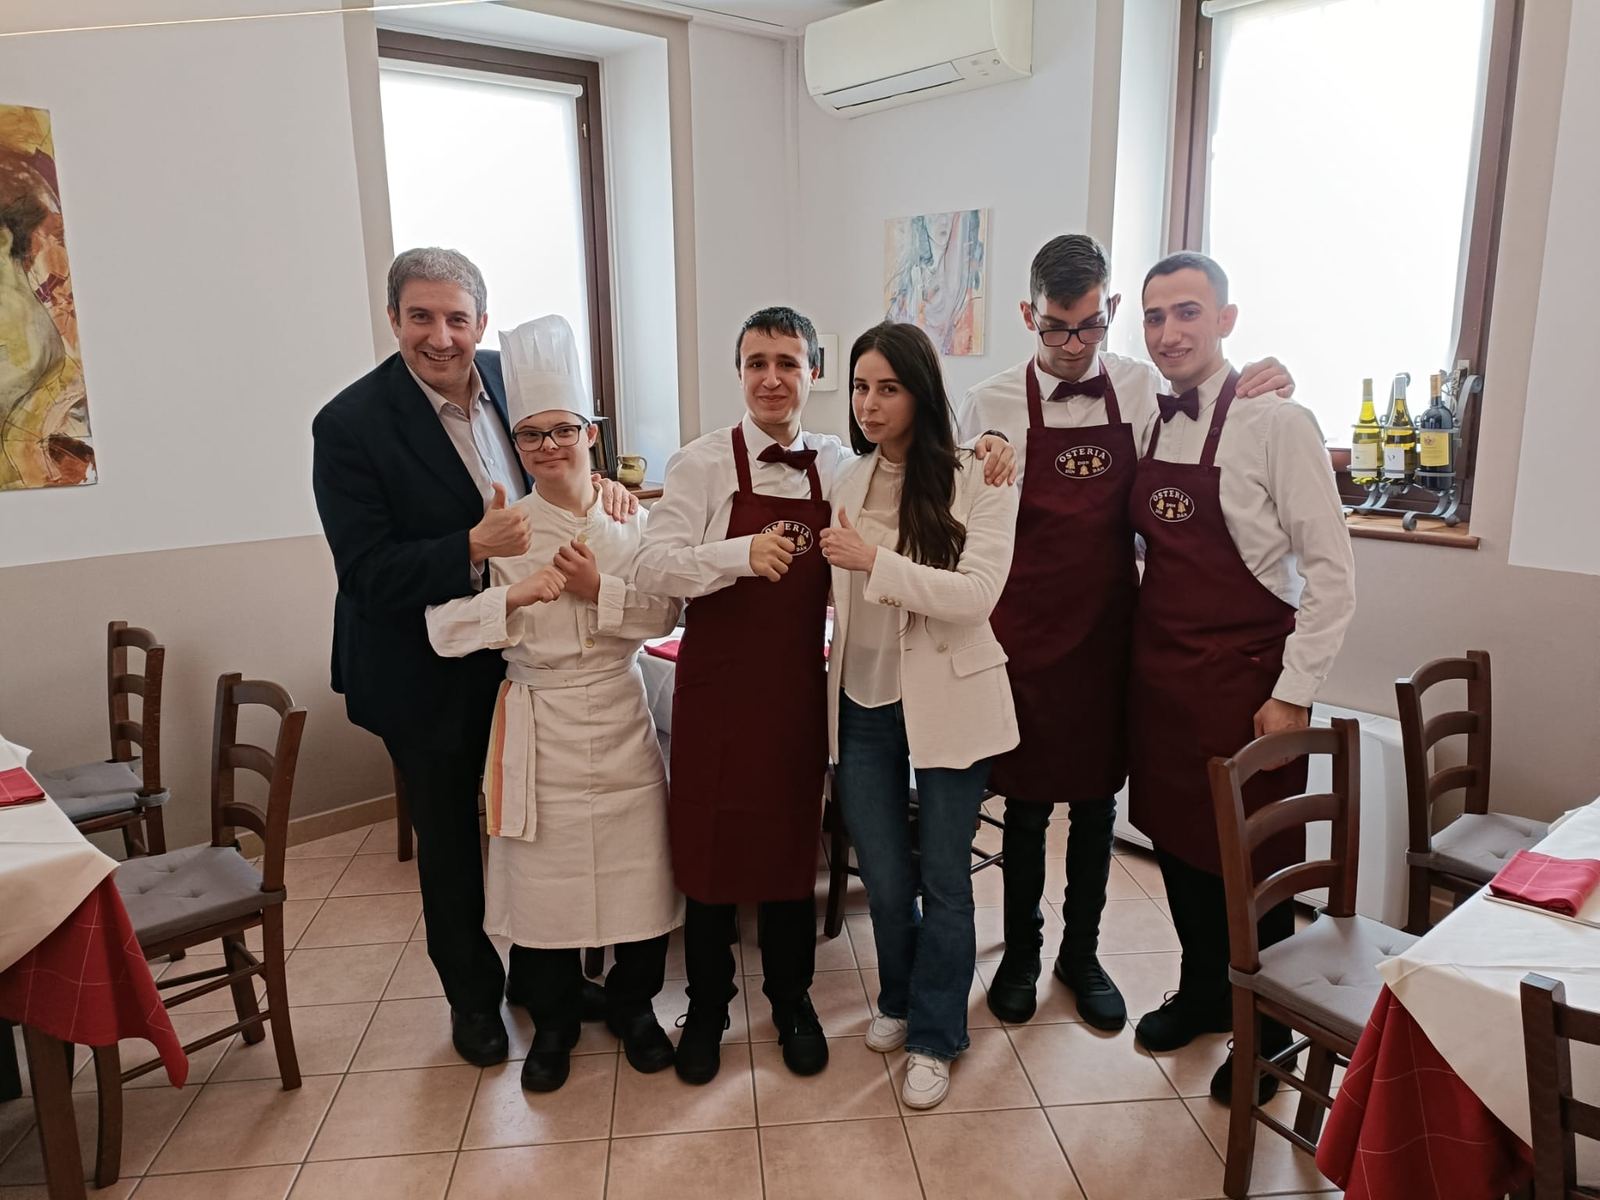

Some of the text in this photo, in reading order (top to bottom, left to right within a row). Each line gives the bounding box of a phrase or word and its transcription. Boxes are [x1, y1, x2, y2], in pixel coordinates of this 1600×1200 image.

[1059, 448, 1106, 462] OSTERIA
[1152, 490, 1189, 506] OSTERIA
[765, 523, 810, 539] OSERIA
